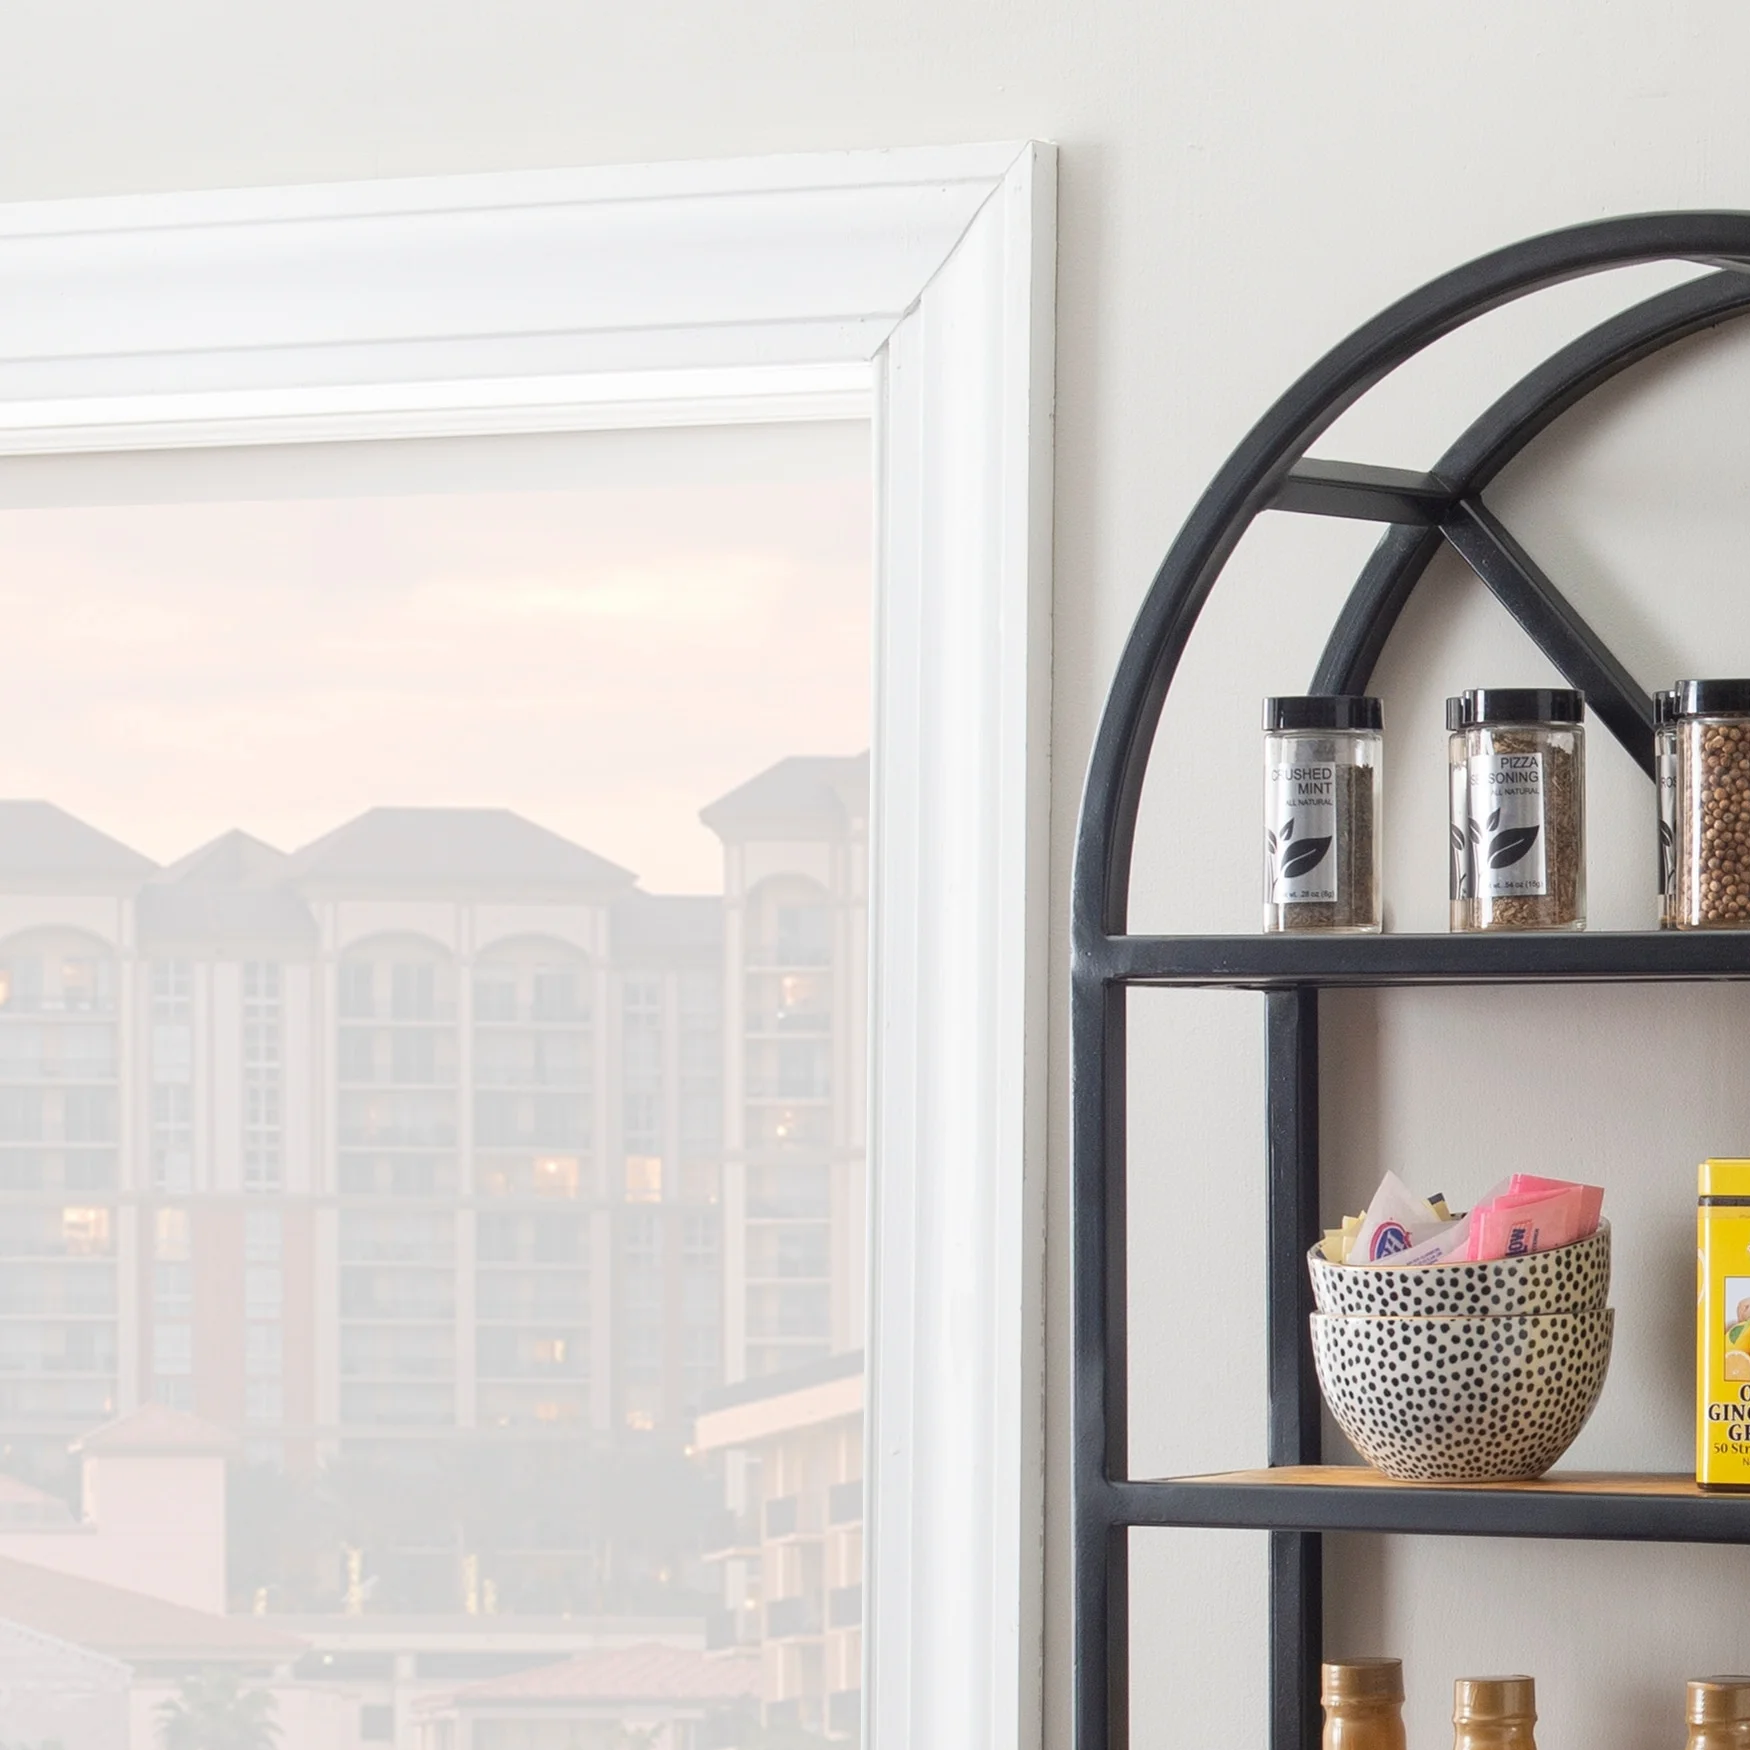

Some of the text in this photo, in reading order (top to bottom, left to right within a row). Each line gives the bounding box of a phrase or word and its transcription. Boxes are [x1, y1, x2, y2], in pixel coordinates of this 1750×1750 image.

[1501, 757, 1539, 769] PIZZA
[1271, 768, 1333, 781] CUSHED
[1298, 782, 1333, 794] MINT
[1505, 787, 1540, 795] NATURAL
[1714, 1443, 1728, 1454] 50
